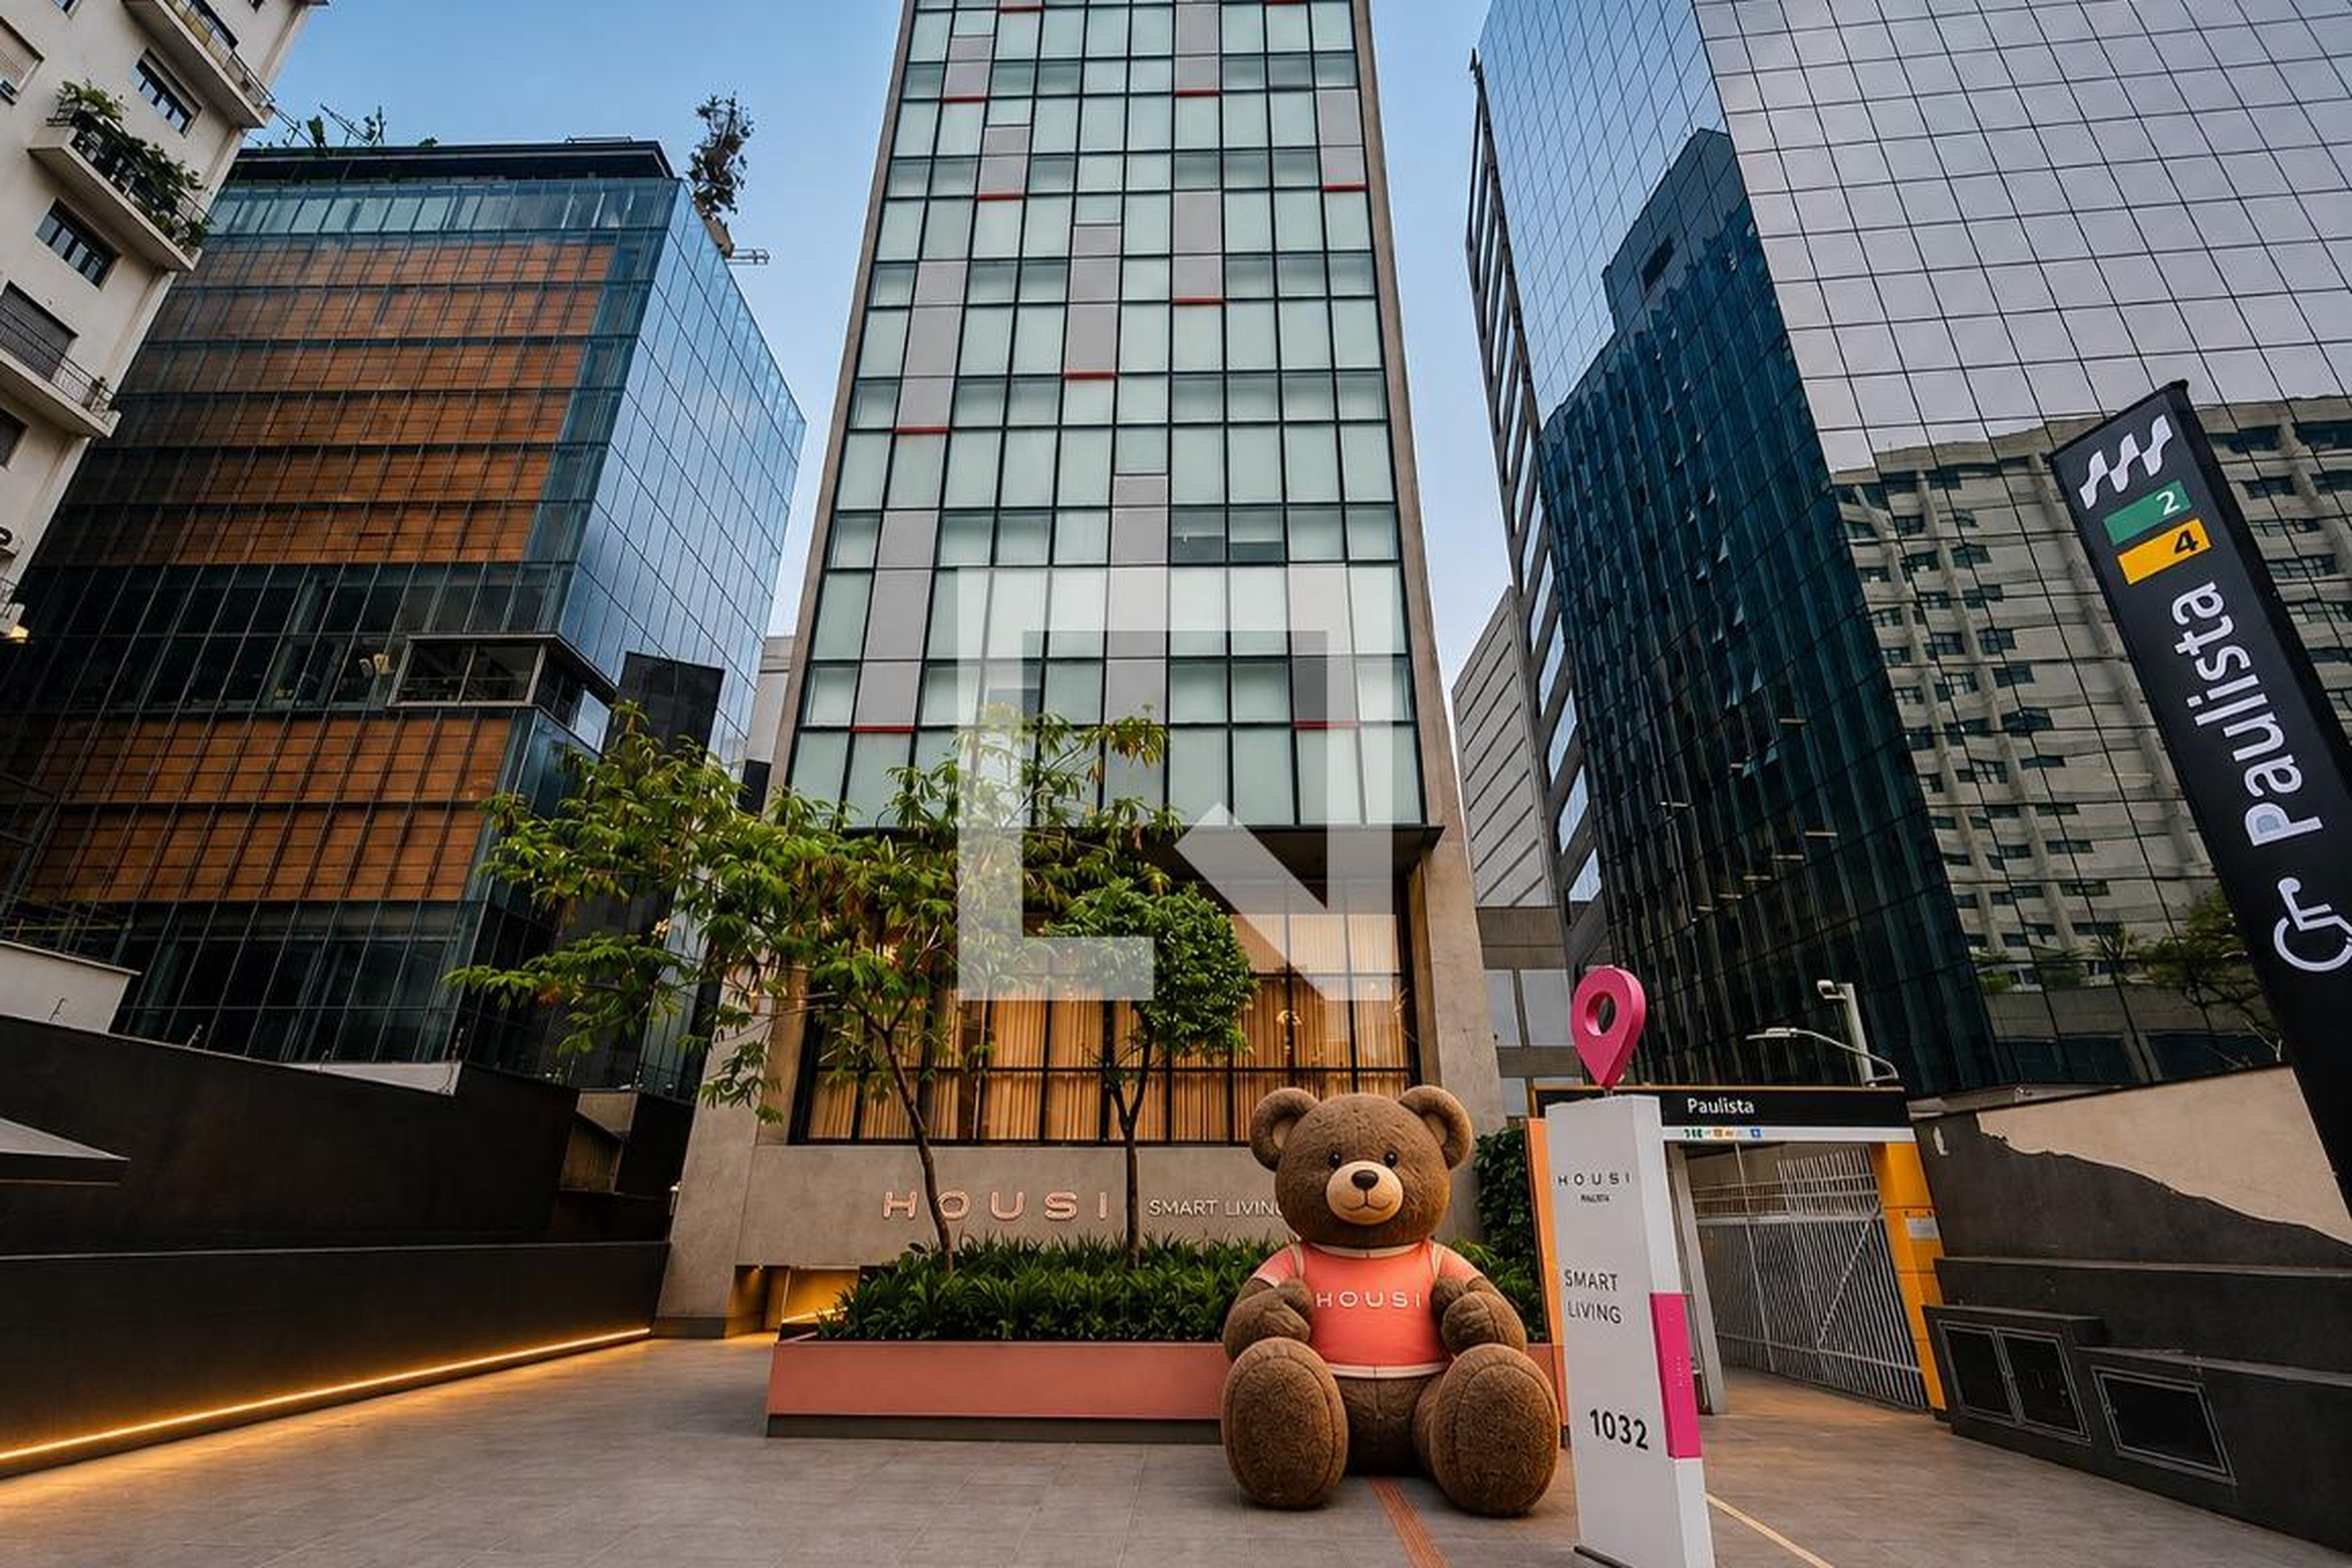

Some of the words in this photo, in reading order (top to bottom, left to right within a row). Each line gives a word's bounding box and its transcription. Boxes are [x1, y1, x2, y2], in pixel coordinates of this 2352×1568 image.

[2156, 491, 2180, 515] 2
[2174, 530, 2198, 554] 4
[2171, 581, 2323, 846] Paulista
[1687, 1096, 1754, 1114] Paulista
[1558, 1172, 1629, 1186] HOUSI
[882, 1191, 1107, 1219] HOUSI
[1149, 1200, 1218, 1215] SMART
[1565, 1270, 1618, 1291] SMART
[1316, 1291, 1420, 1308] HOUSI
[1568, 1301, 1621, 1324] LIVING
[1590, 1409, 1648, 1450] 1032
